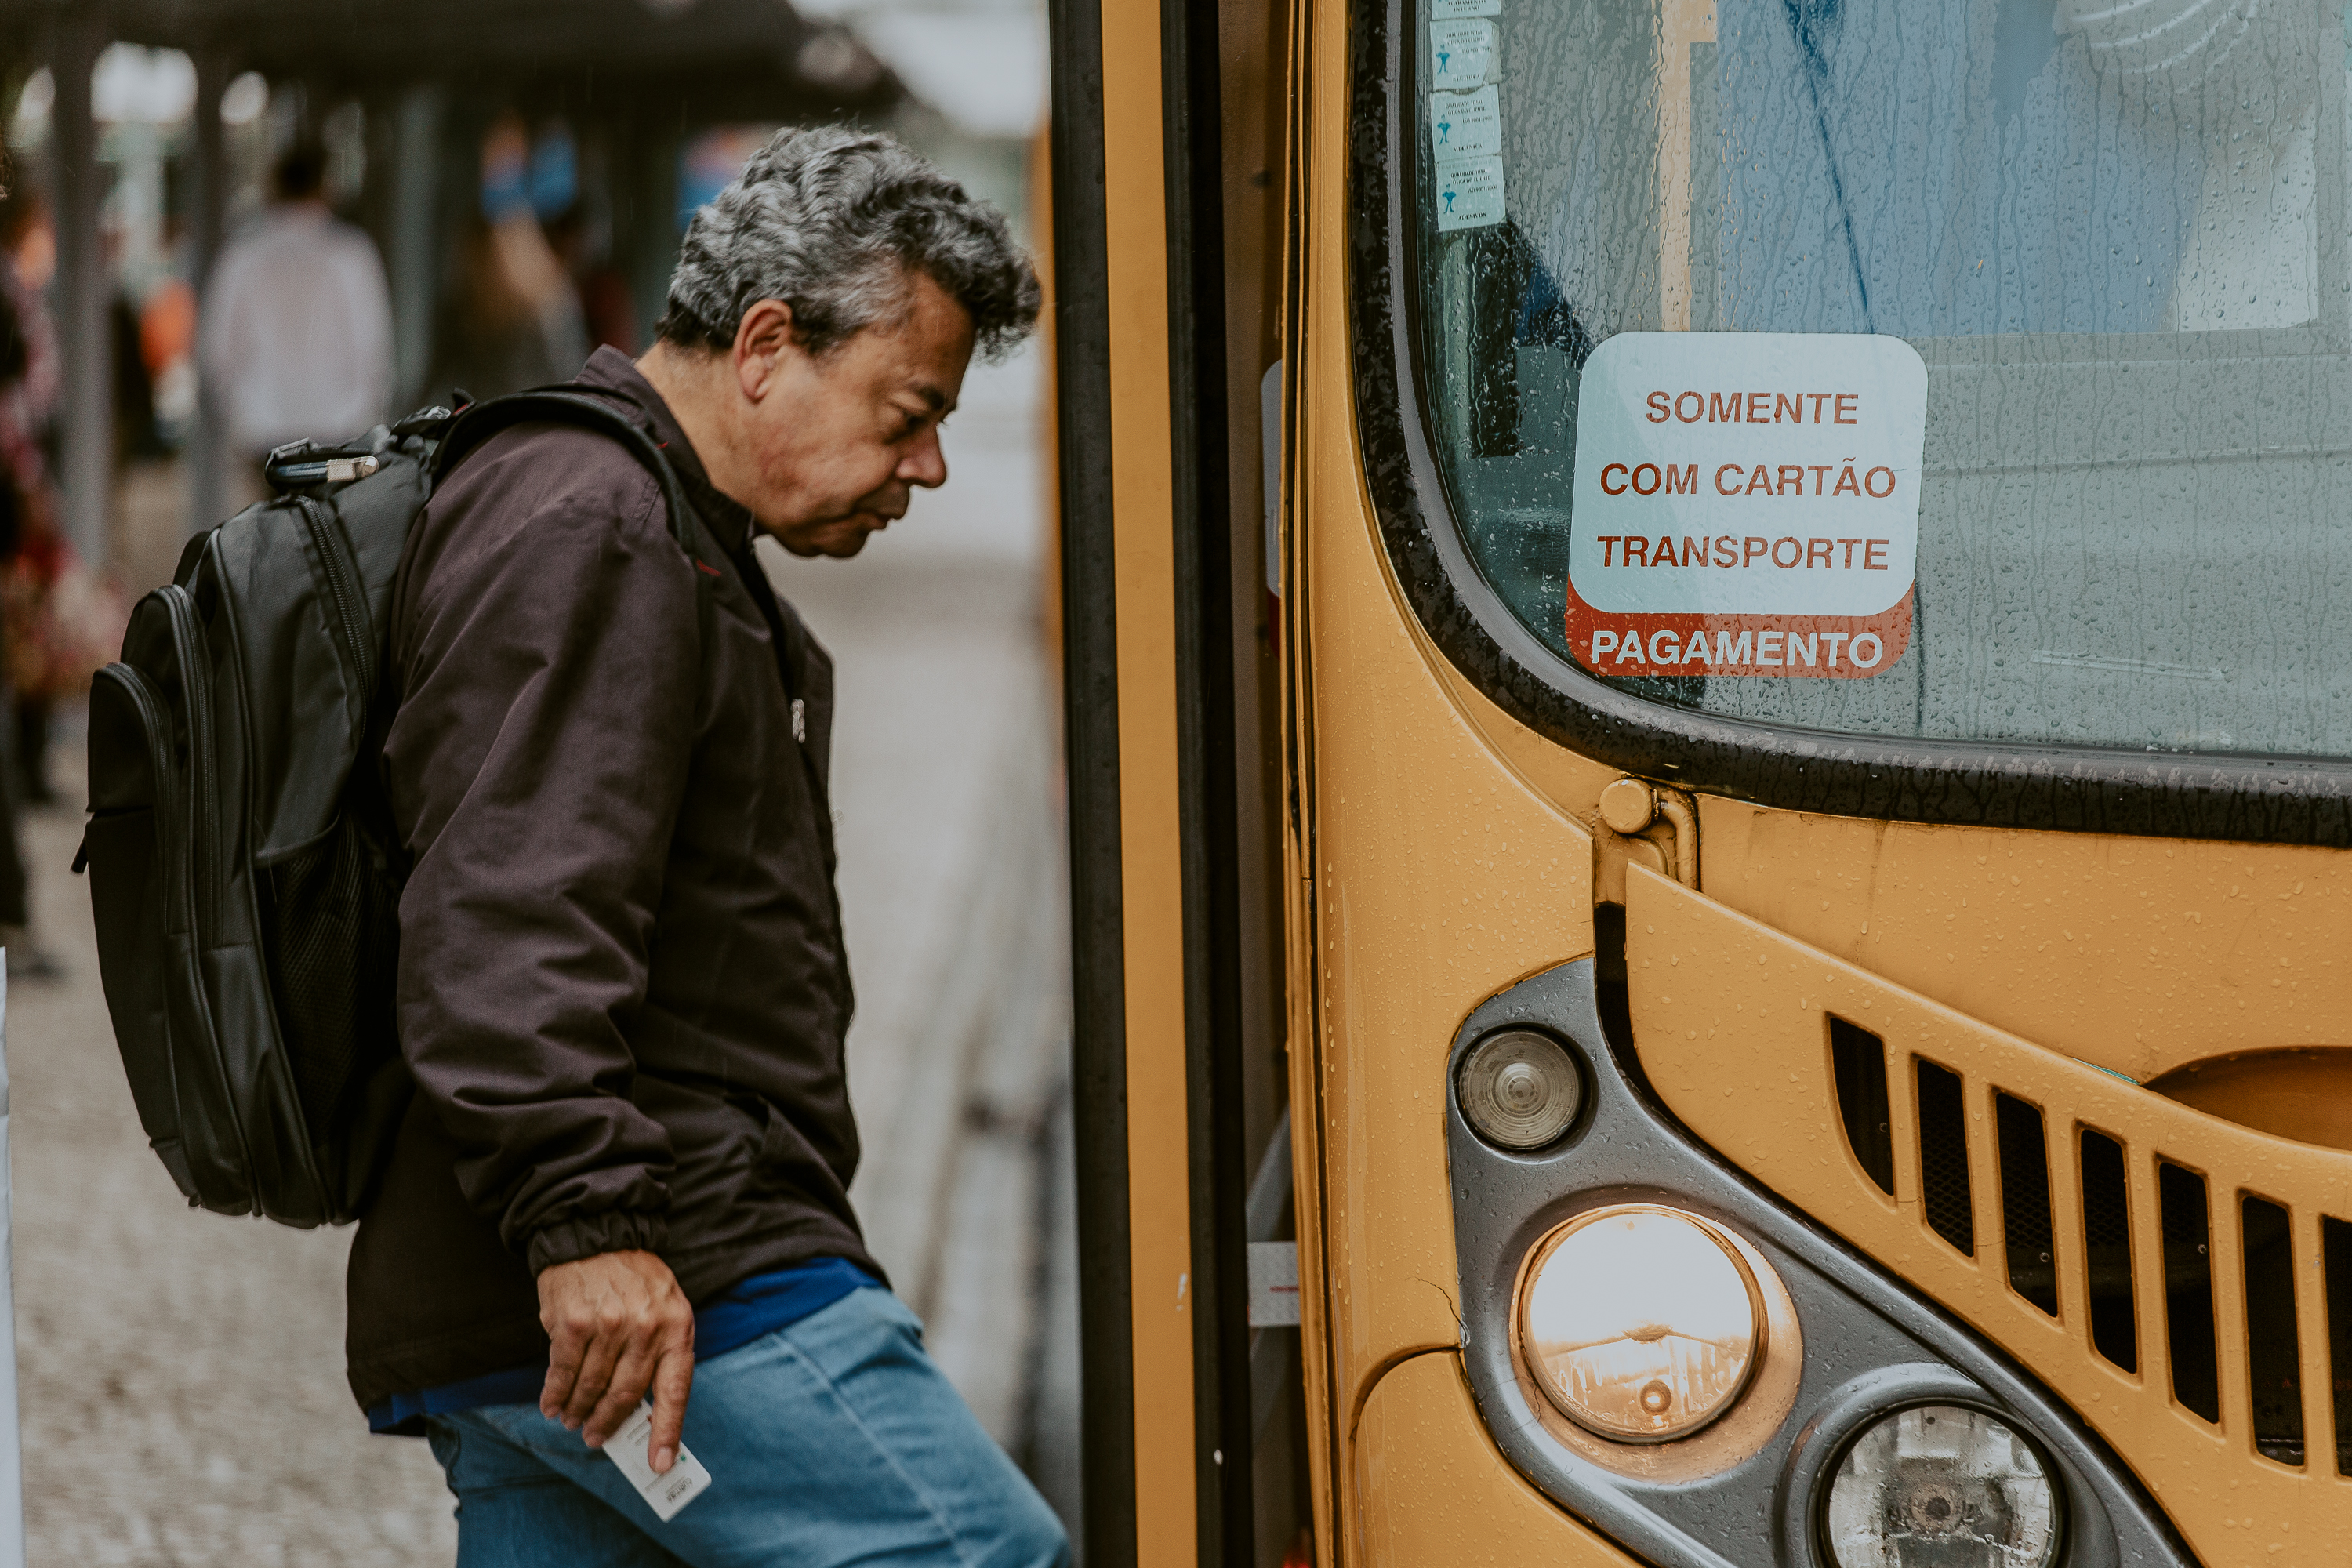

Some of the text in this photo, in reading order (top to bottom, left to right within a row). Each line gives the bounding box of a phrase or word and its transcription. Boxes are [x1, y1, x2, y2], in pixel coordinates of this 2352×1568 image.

[1458, 211, 1486, 220] ADESIVOS
[1645, 390, 1859, 425] SOMENTE
[1600, 456, 1896, 499] COM CARTÃO
[1597, 535, 1890, 571] TRANSPORTE
[1591, 630, 1883, 669] PAGAMENTO
